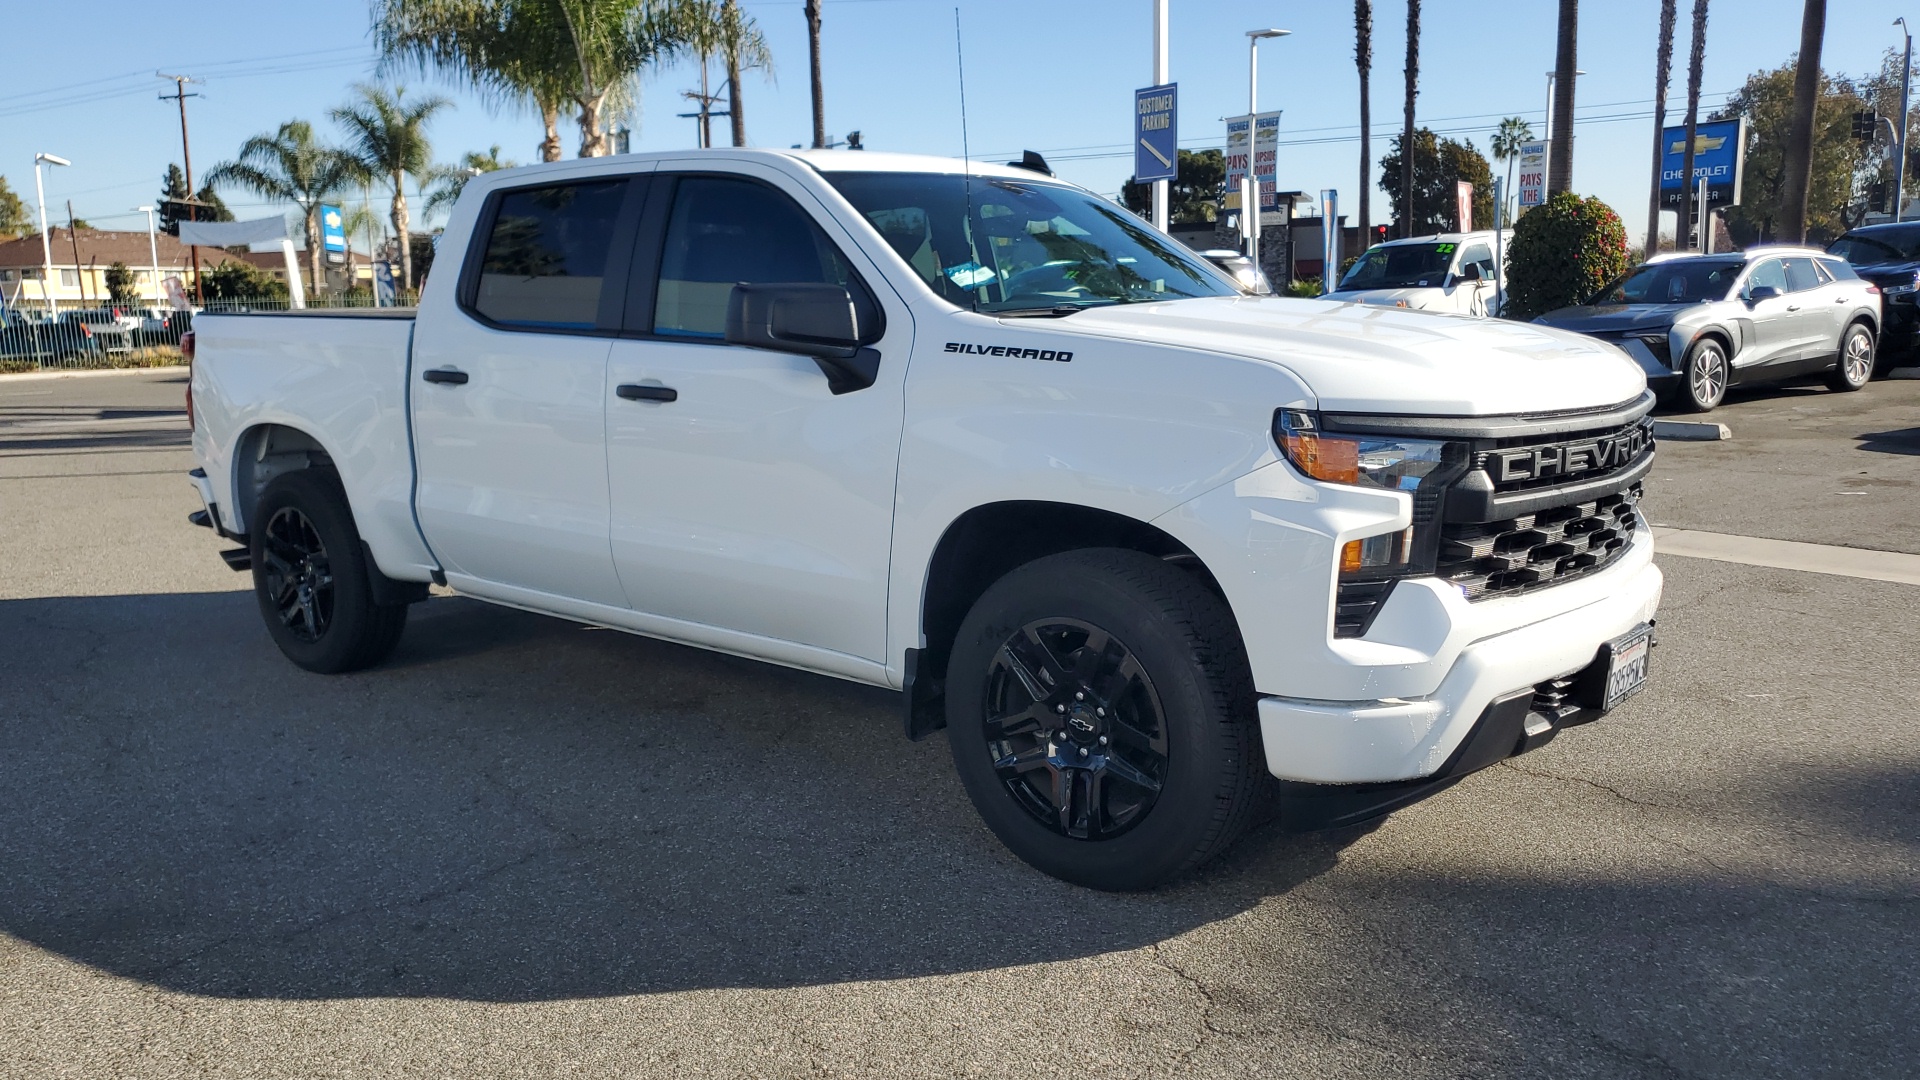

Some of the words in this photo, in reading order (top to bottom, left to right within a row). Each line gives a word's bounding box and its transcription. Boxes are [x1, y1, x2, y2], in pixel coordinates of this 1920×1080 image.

[1138, 94, 1173, 115] CUSTOMER
[1141, 113, 1170, 131] PARKING
[1227, 120, 1250, 133] PREMIER
[1256, 116, 1280, 129] PREMIER
[1520, 144, 1544, 155] PREMIER
[1226, 153, 1249, 170] PAYS
[1255, 150, 1276, 163] UPSIDE
[1254, 163, 1276, 176] DOWN?
[1663, 165, 1729, 180] CHEROLET
[1520, 172, 1543, 187] PAYS
[1522, 189, 1539, 203] THE
[1669, 190, 1719, 203] PRMER
[1436, 243, 1454, 254] 22
[944, 342, 1073, 362] SILVERADO
